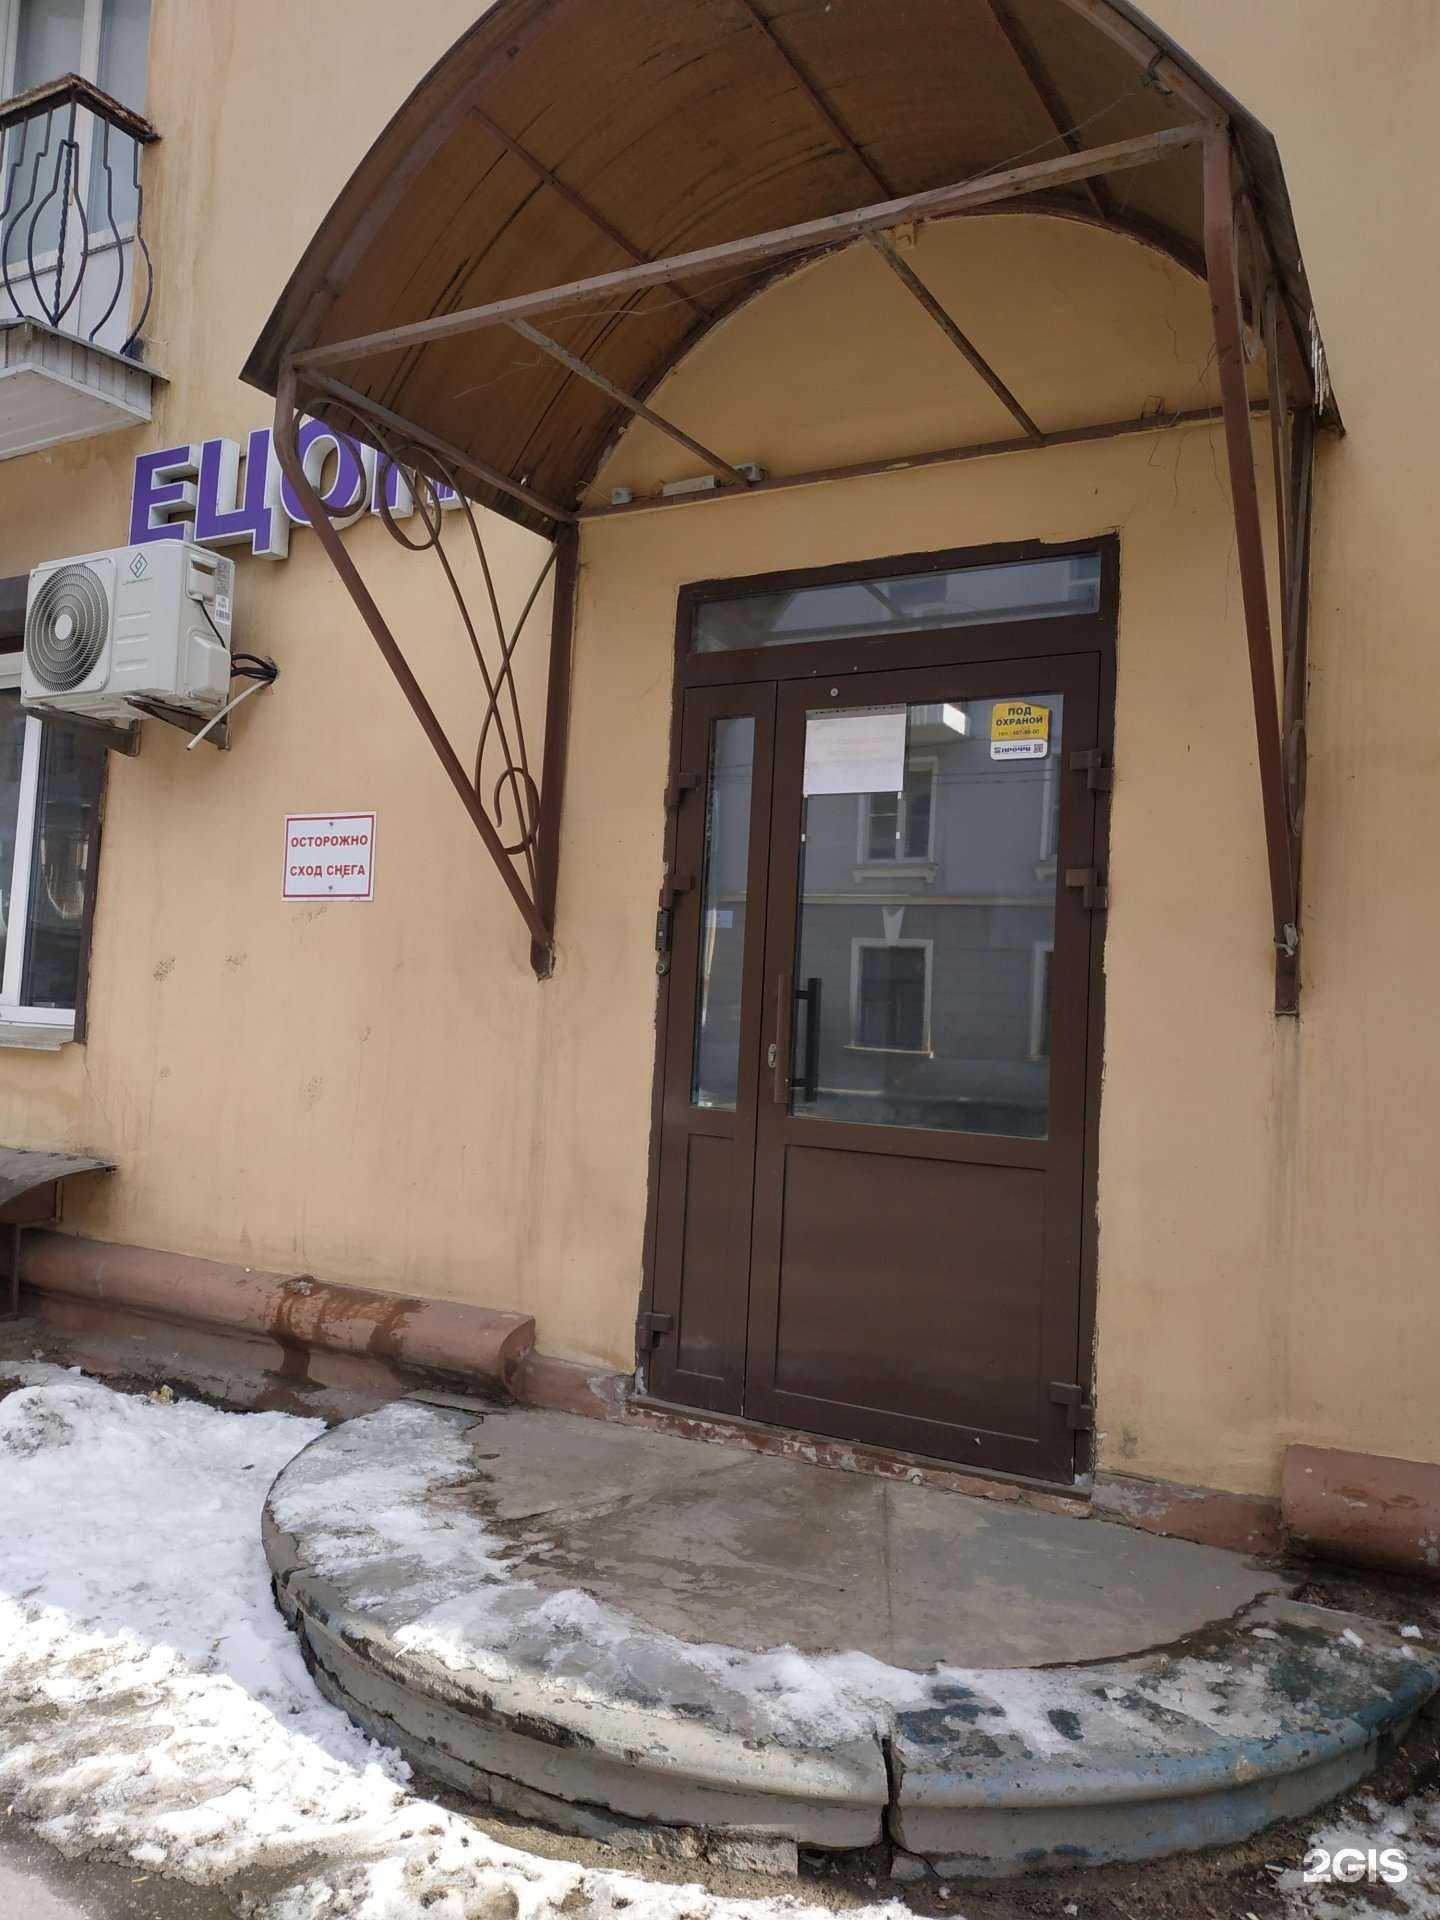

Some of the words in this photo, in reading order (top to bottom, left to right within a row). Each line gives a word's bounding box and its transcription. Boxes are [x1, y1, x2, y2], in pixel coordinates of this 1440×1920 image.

[1007, 706, 1032, 716] ПОД
[995, 715, 1043, 727] ОХРАНОЙ
[291, 835, 368, 847] ОСТОРОЖНО
[290, 865, 323, 878] СХОД
[326, 865, 366, 876] СНЕГА
